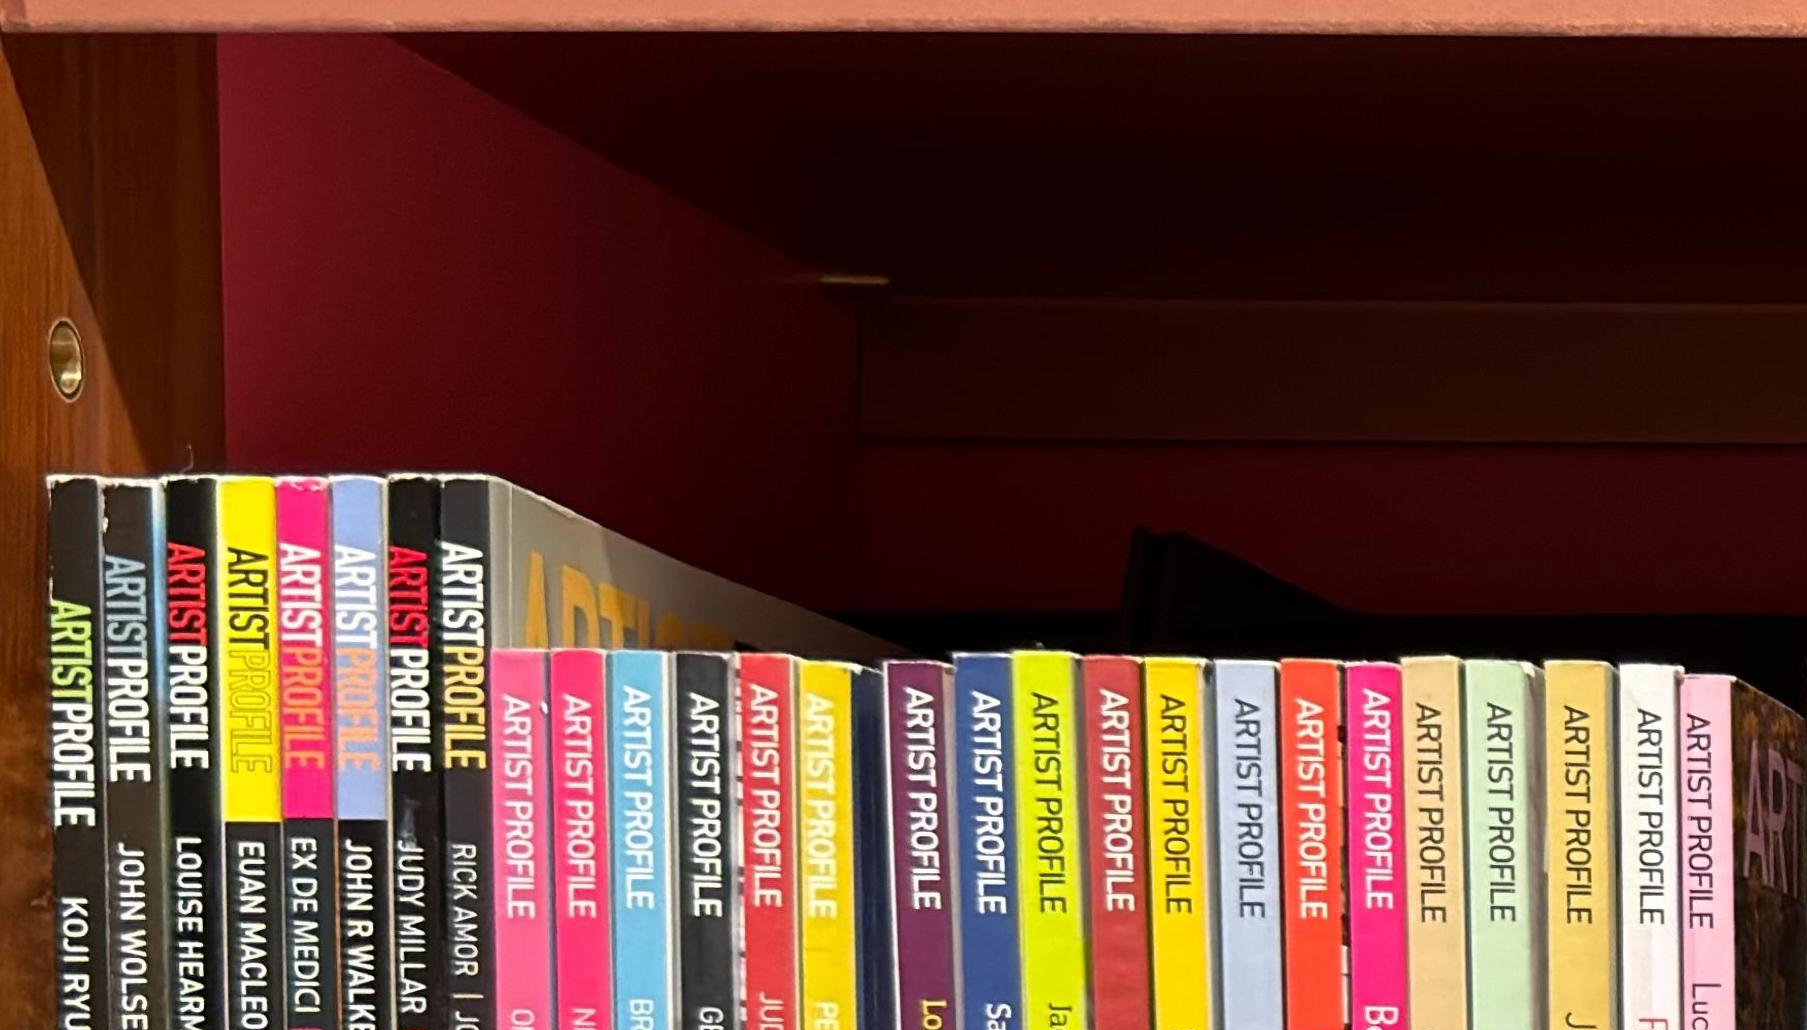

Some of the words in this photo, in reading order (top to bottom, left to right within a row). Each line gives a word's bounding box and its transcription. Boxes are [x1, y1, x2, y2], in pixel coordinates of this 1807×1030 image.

[504, 694, 532, 795] ARTIST
[624, 686, 651, 785] ARTIST
[688, 692, 717, 792] ARTIST
[805, 693, 834, 794] ARTIST
[972, 691, 1002, 790] ARTIST
[1100, 689, 1130, 785] ARTIST
[1235, 699, 1262, 796] ARTIST
[1297, 699, 1325, 797] ARTIST
[1487, 702, 1512, 799] ARTIST
[1686, 714, 1710, 809] ARTIST
[175, 837, 203, 933] LOUISE
[237, 841, 265, 913] EUAN
[344, 839, 373, 910] JOHN
[452, 843, 477, 903] RICK
[507, 802, 535, 918] PROFILE
[627, 792, 654, 908] PROFILE
[694, 799, 721, 916] PROFILE
[808, 801, 835, 918] PROFILE
[975, 797, 1005, 914] PROFILE
[1104, 793, 1133, 911] PROFILE
[1237, 802, 1265, 918] PROFILE
[1300, 803, 1327, 919] PROFILE
[1489, 806, 1515, 922] PROFILE
[1688, 815, 1713, 929] PROFILE
[60, 897, 89, 966] KOJI
[345, 919, 373, 938] R
[453, 909, 478, 976] AMOR
